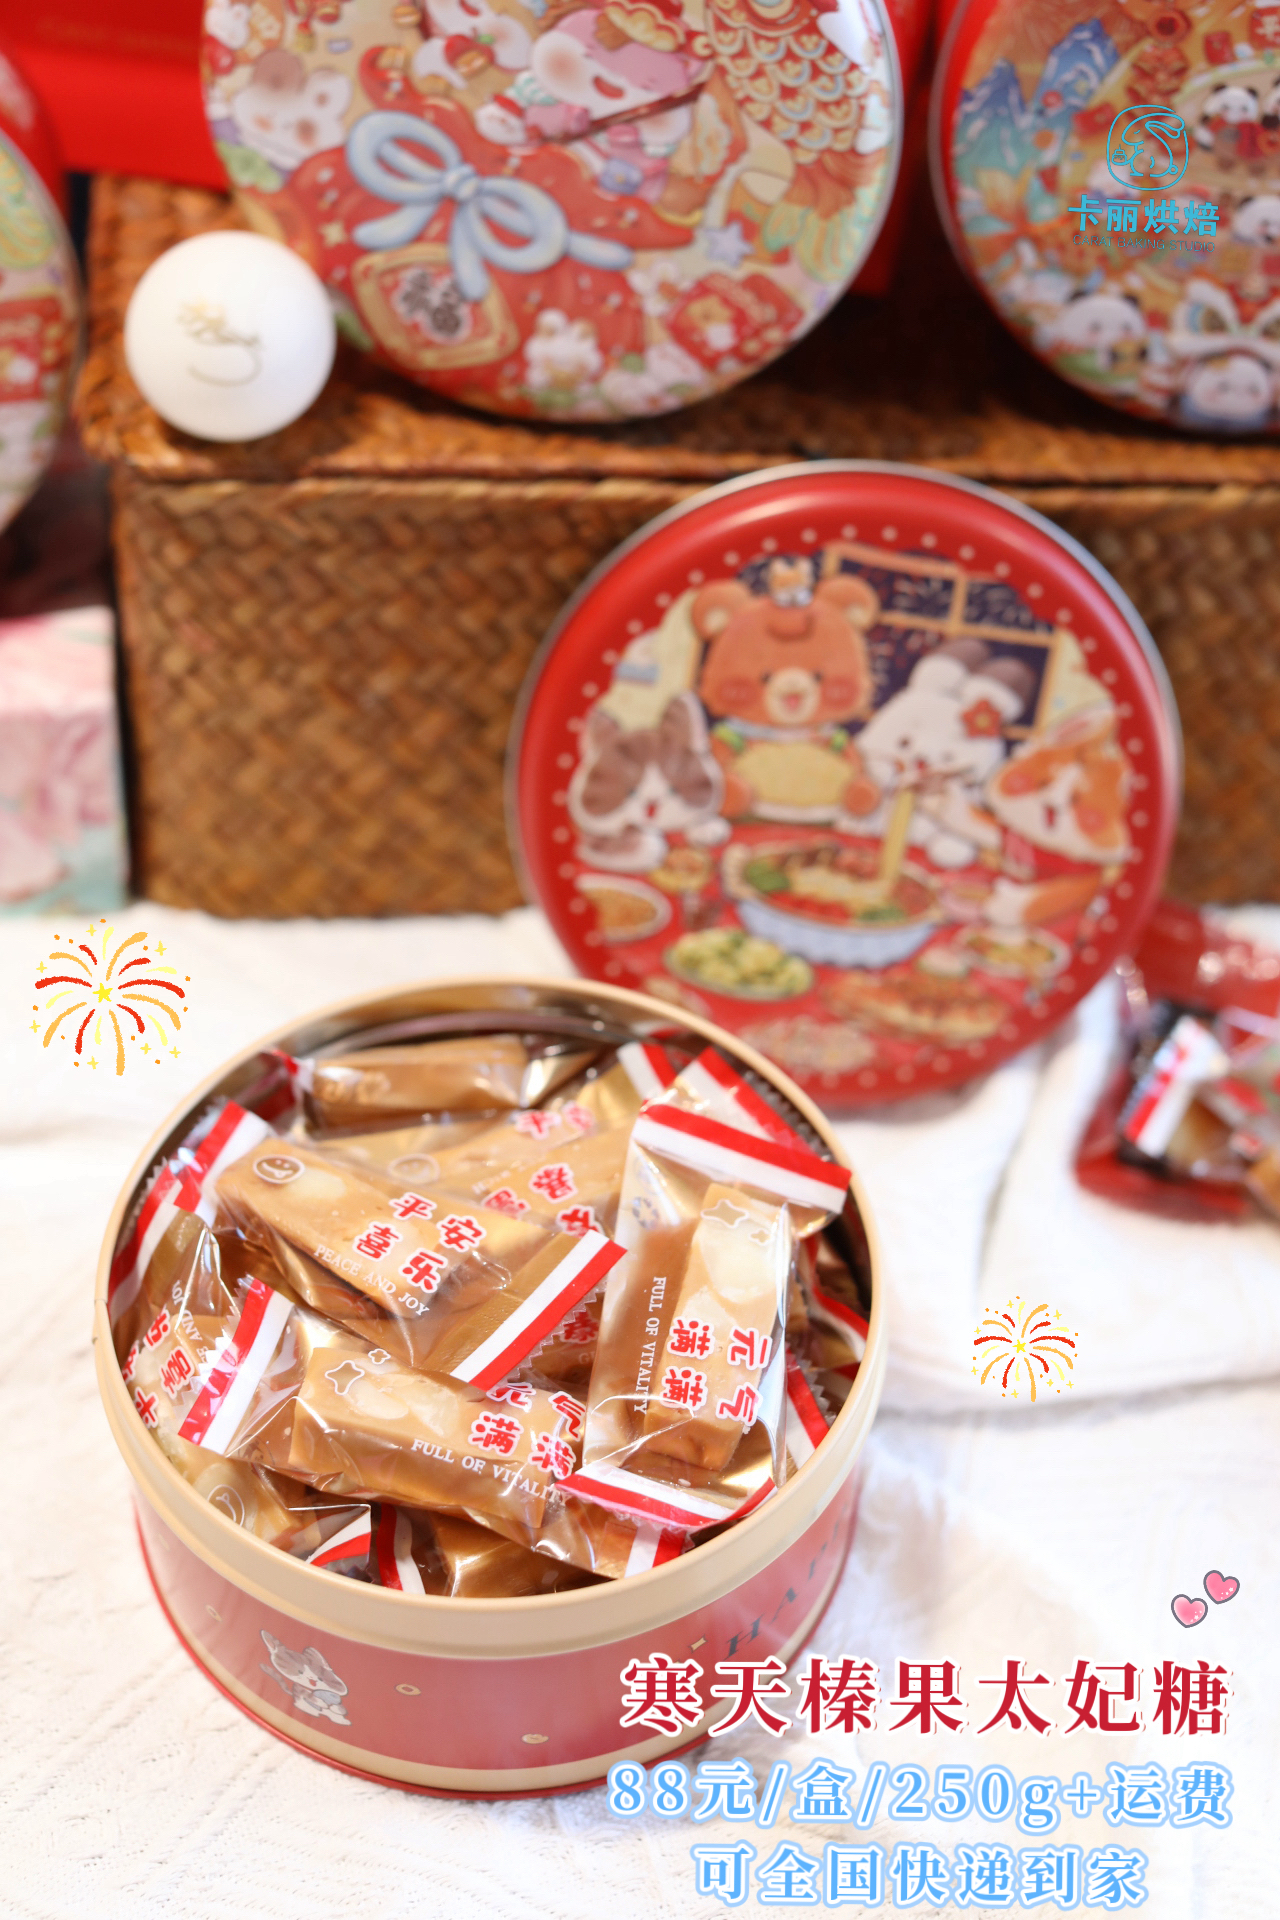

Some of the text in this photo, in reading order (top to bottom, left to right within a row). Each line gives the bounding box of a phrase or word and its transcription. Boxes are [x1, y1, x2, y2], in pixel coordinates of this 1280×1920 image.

[355, 1223, 446, 1292] 喜乐
[391, 1194, 484, 1250] 平安
[314, 1244, 430, 1316] PEACE AND JOY
[634, 1277, 667, 1414] FULL OF VITALITY
[663, 1319, 711, 1407] 满满
[718, 1328, 768, 1424] 元气
[411, 1439, 572, 1505] FULL OF VITALITY
